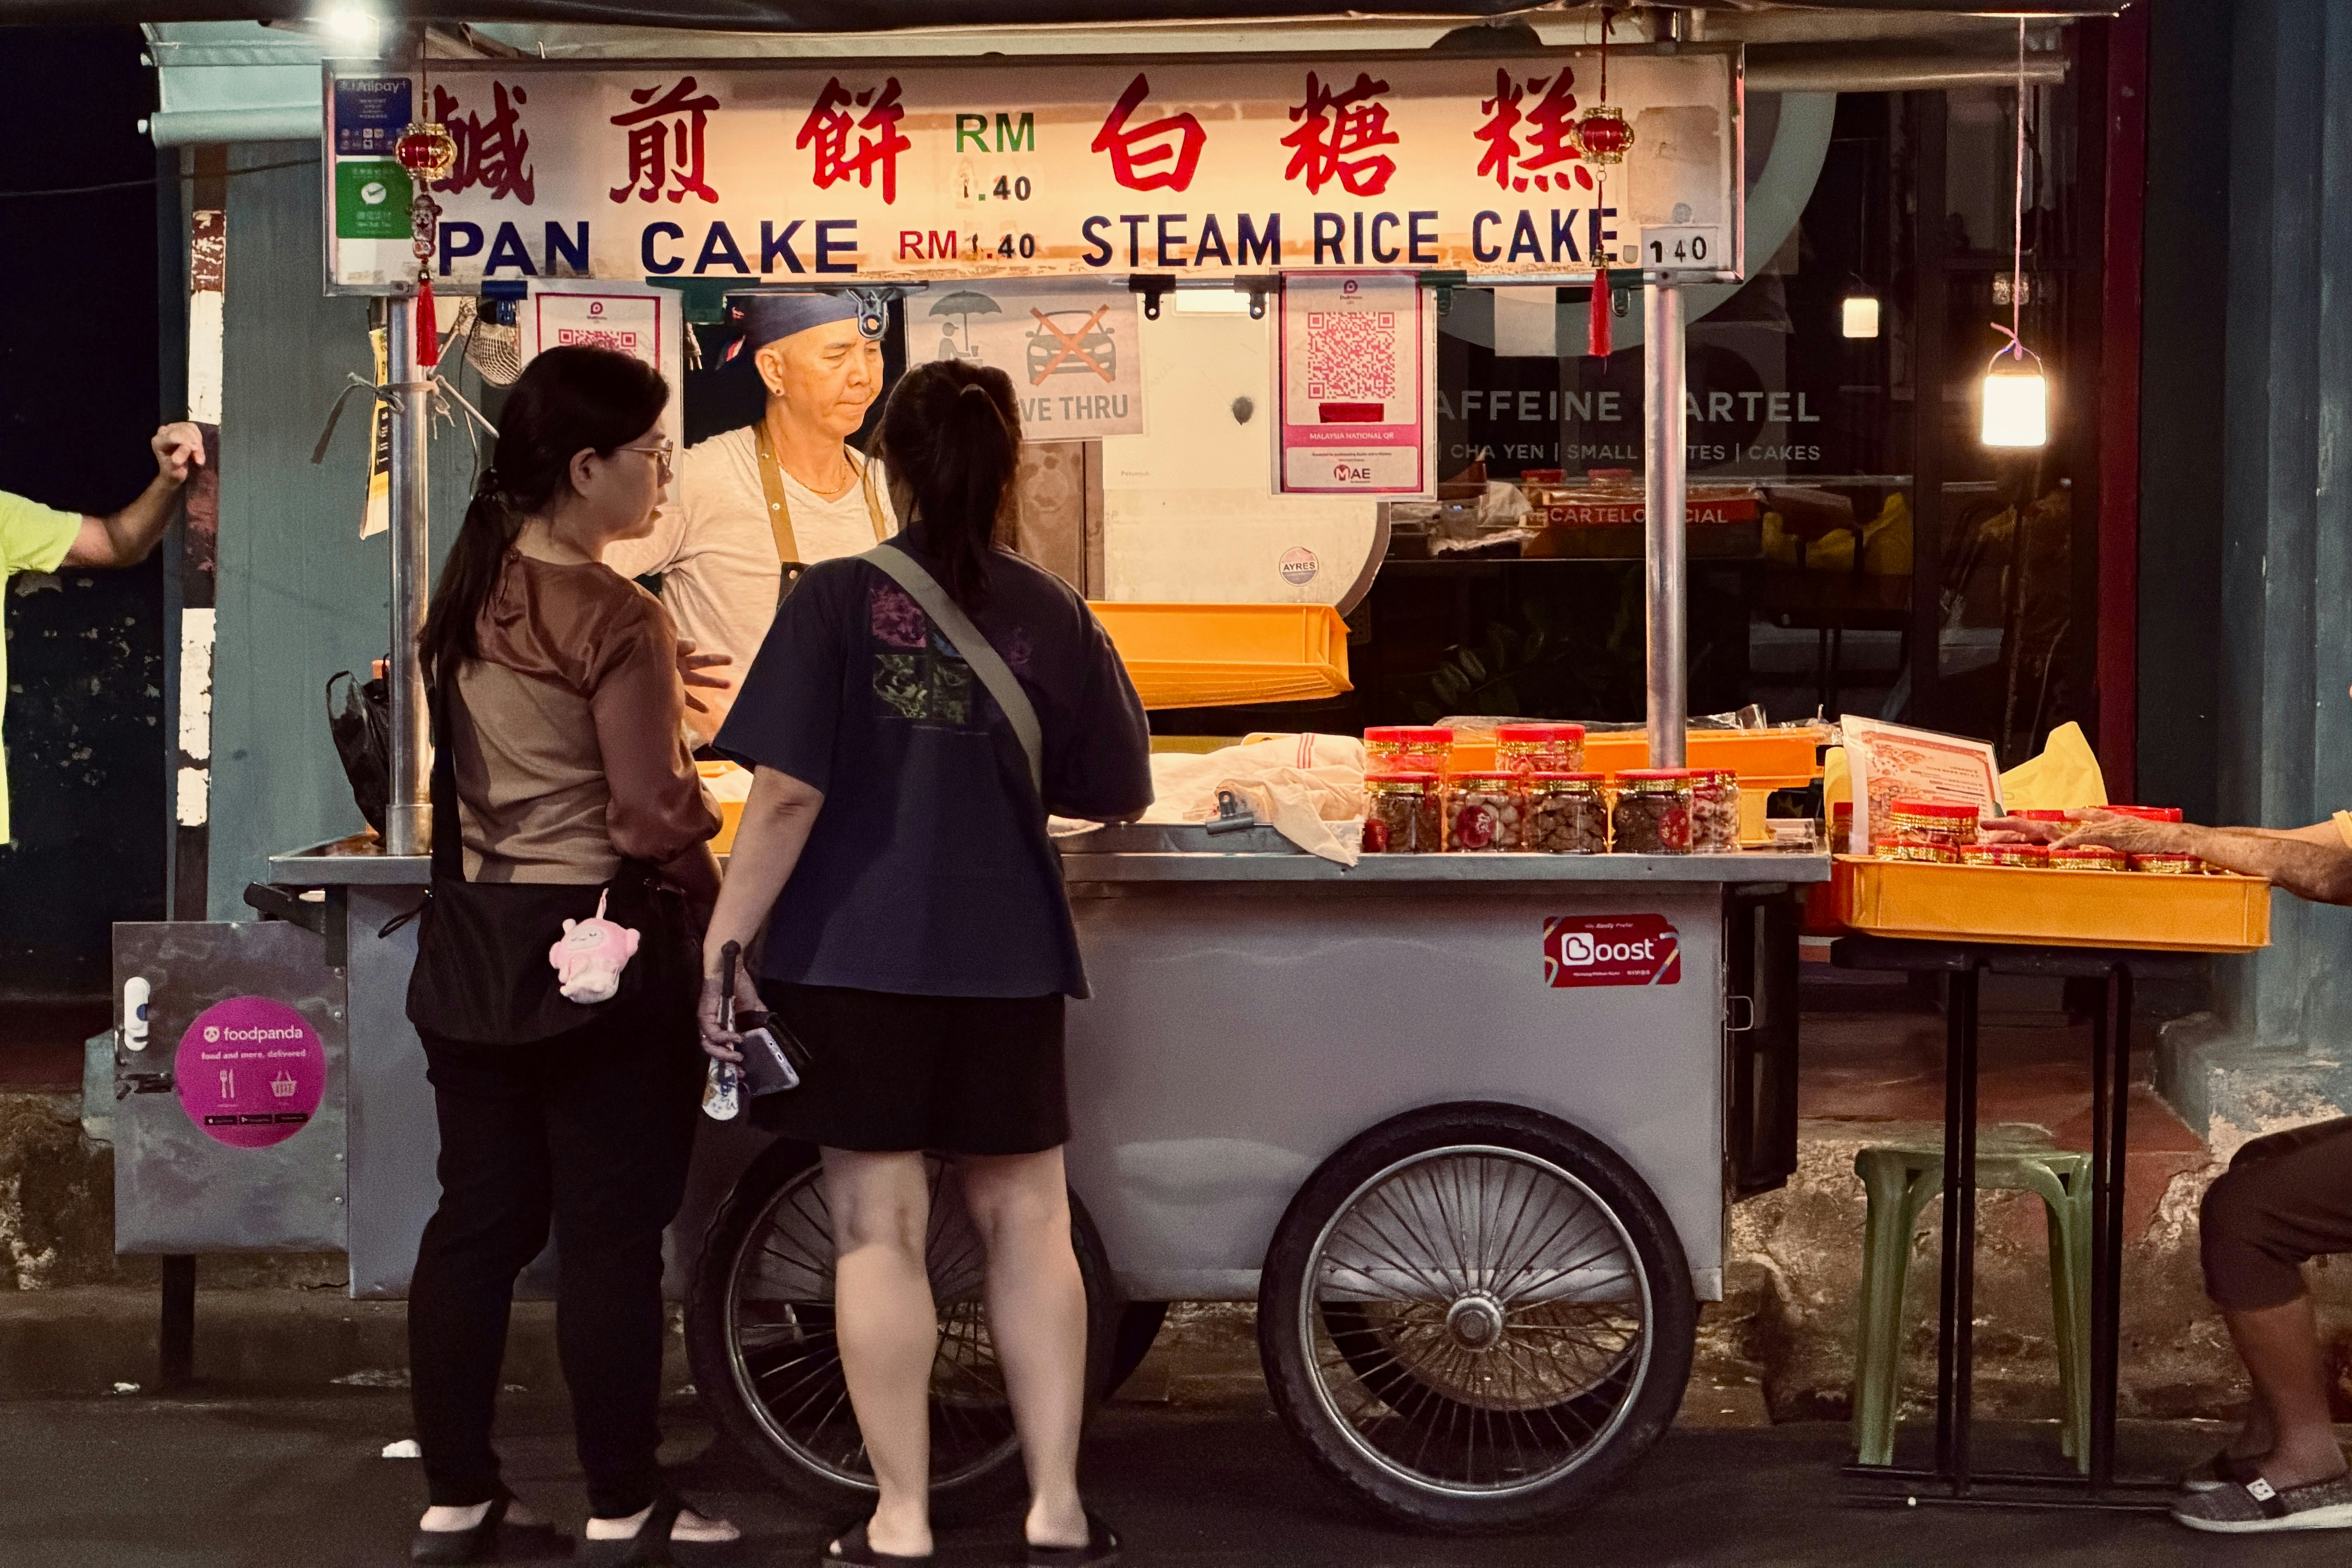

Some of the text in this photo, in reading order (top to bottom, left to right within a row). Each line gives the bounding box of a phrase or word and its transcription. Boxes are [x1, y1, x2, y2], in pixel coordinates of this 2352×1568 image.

[956, 112, 1035, 153] RM
[1091, 66, 1594, 197] 白糖糕
[439, 221, 590, 276] PAN
[640, 218, 858, 275] CAKE
[900, 230, 957, 259] RM
[1081, 207, 1617, 268] STEAM RICE CAKE
[1059, 394, 1128, 420] THRU
[1437, 390, 1820, 422] AFFEINE ARTEL
[1383, 432, 1394, 440] QR
[1450, 443, 1496, 459] CHA
[1503, 444, 1544, 460] YEN
[1567, 444, 1638, 460] SMALL
[1749, 445, 1820, 461] CAKES
[1334, 464, 1371, 481] MAE
[1283, 562, 1316, 572] AYRES
[224, 1024, 303, 1043] foodpanda
